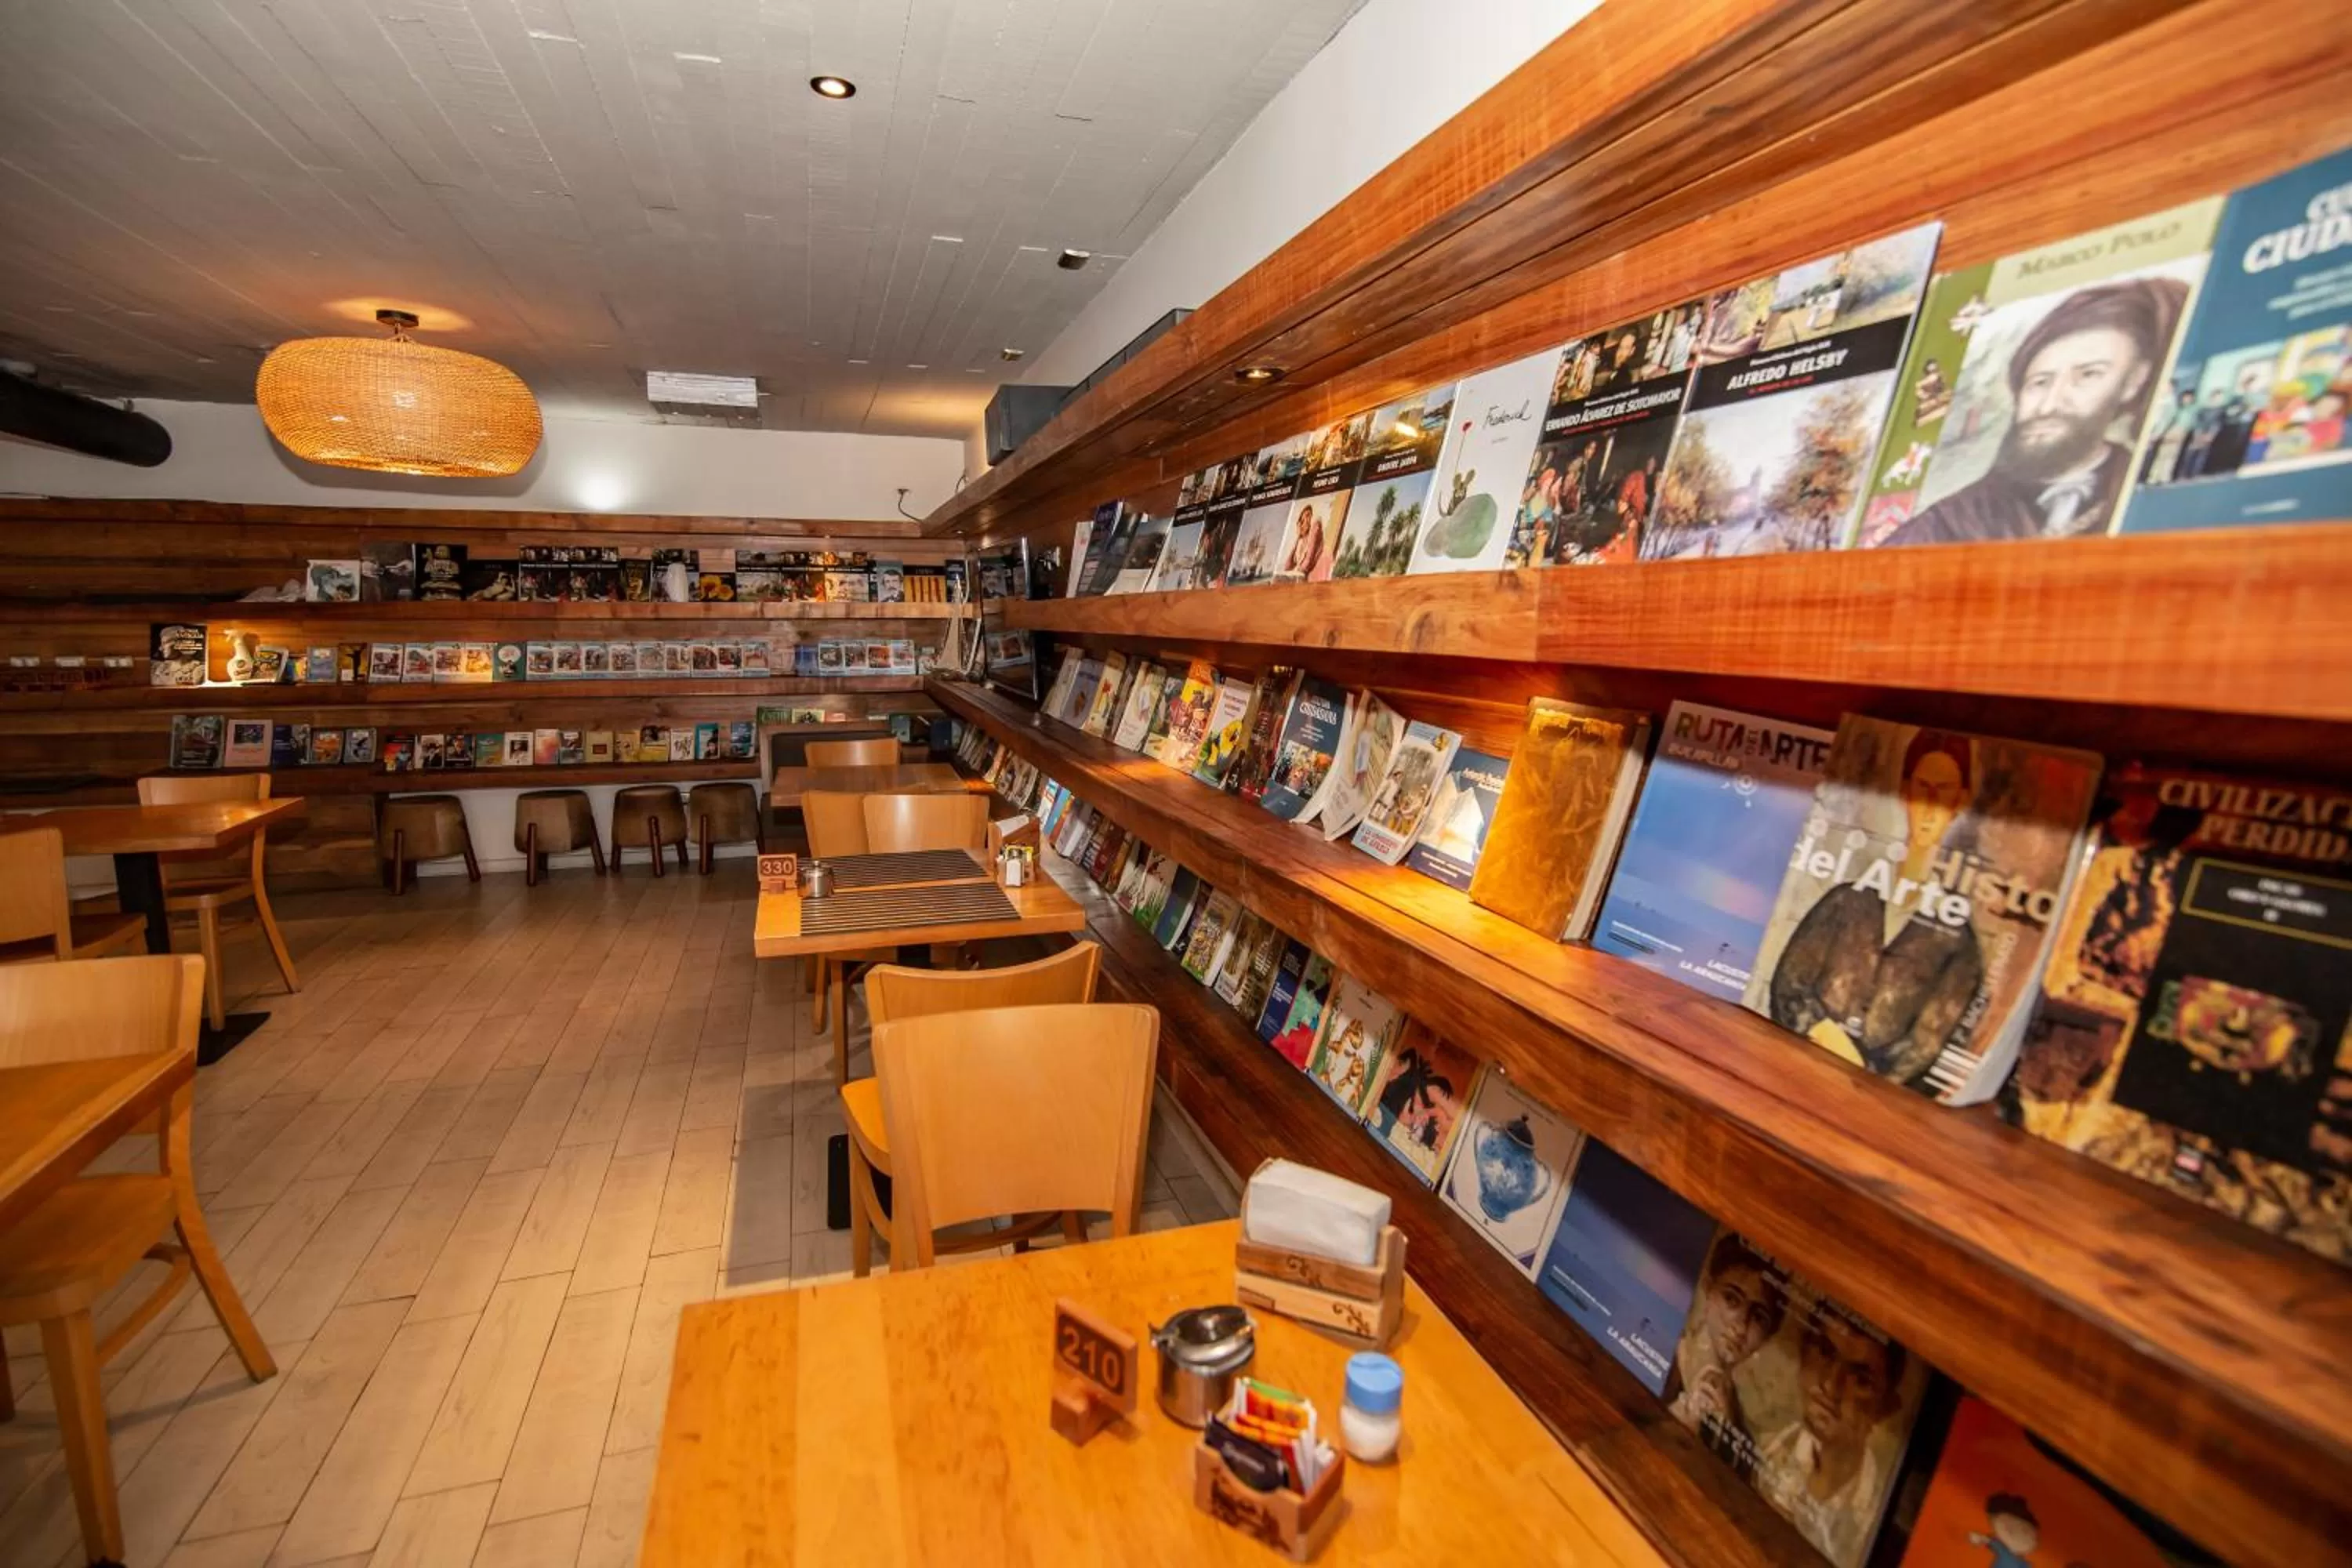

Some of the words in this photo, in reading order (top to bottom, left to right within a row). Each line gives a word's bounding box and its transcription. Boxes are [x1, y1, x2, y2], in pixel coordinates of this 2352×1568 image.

[1726, 364, 1788, 390] ALFREDO
[1788, 348, 1849, 376] HELSBY
[1675, 711, 1745, 752] RUTA
[1759, 728, 1832, 771] ARTE
[761, 860, 793, 874] 330
[1852, 858, 1970, 927] Arte
[1062, 1326, 1120, 1388] 210
